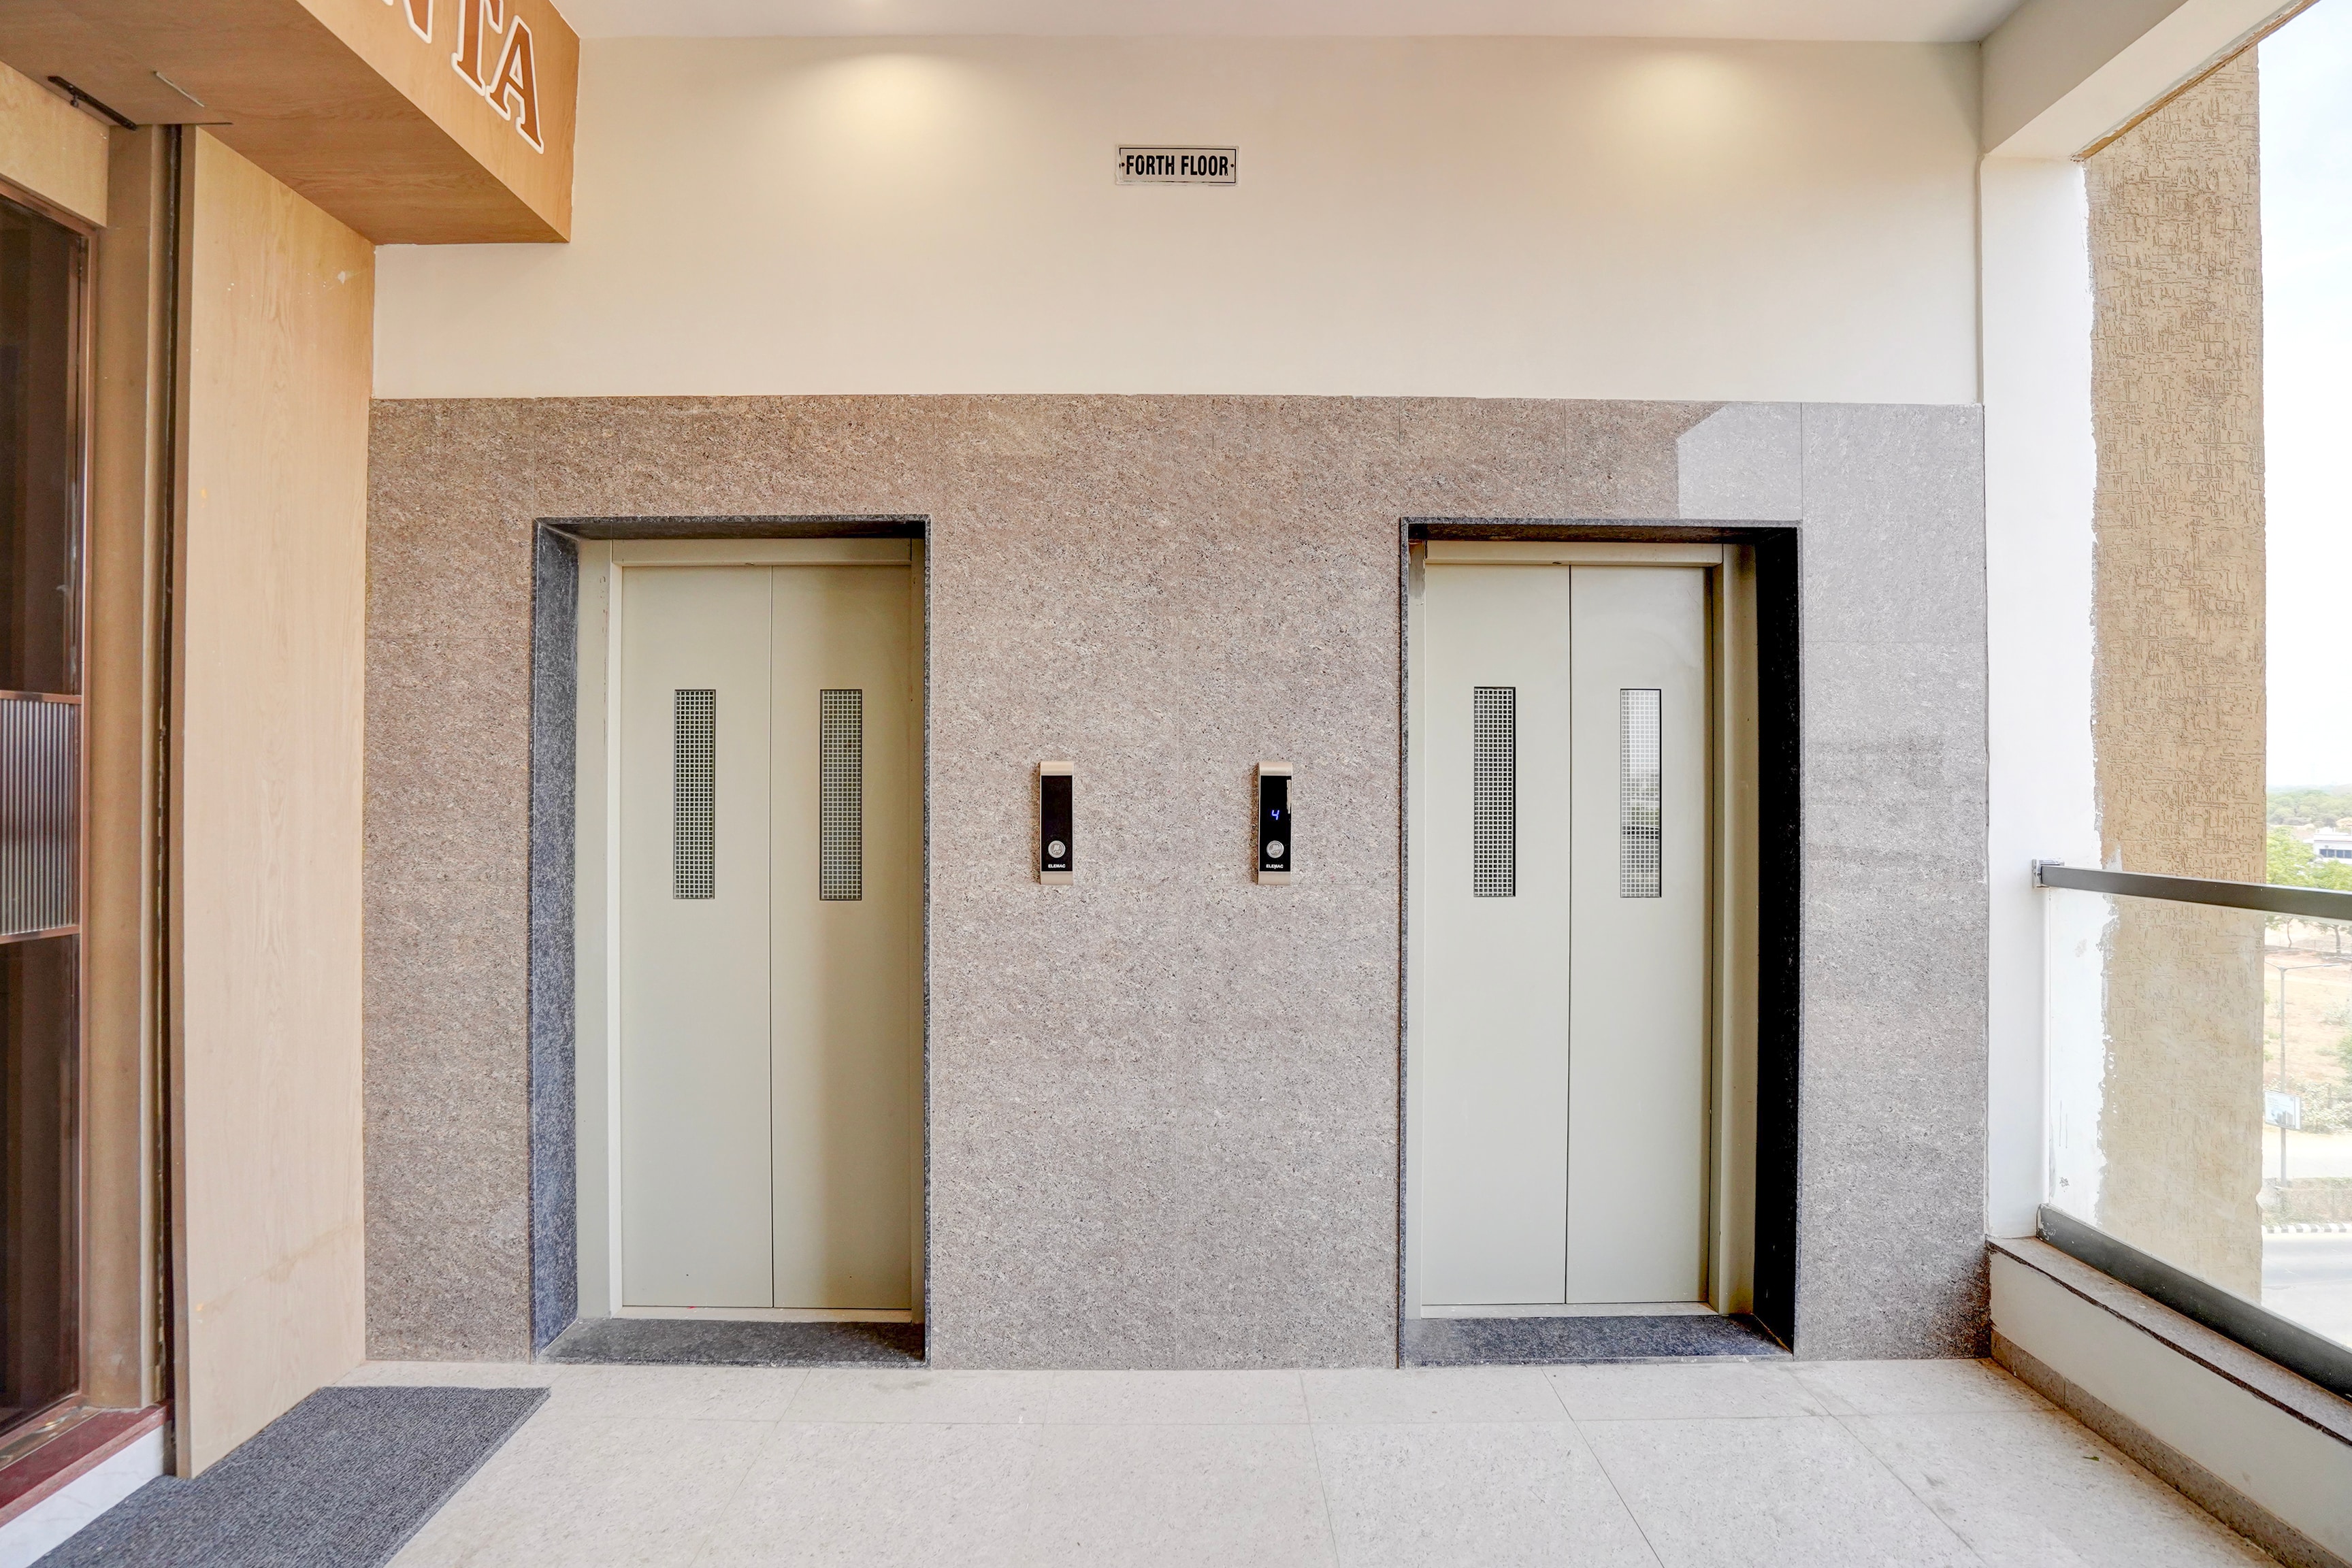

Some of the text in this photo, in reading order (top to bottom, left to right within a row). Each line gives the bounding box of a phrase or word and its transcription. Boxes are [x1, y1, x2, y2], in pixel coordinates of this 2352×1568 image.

[1126, 154, 1228, 176] FORTH FLOOR
[1271, 810, 1280, 821] 4
